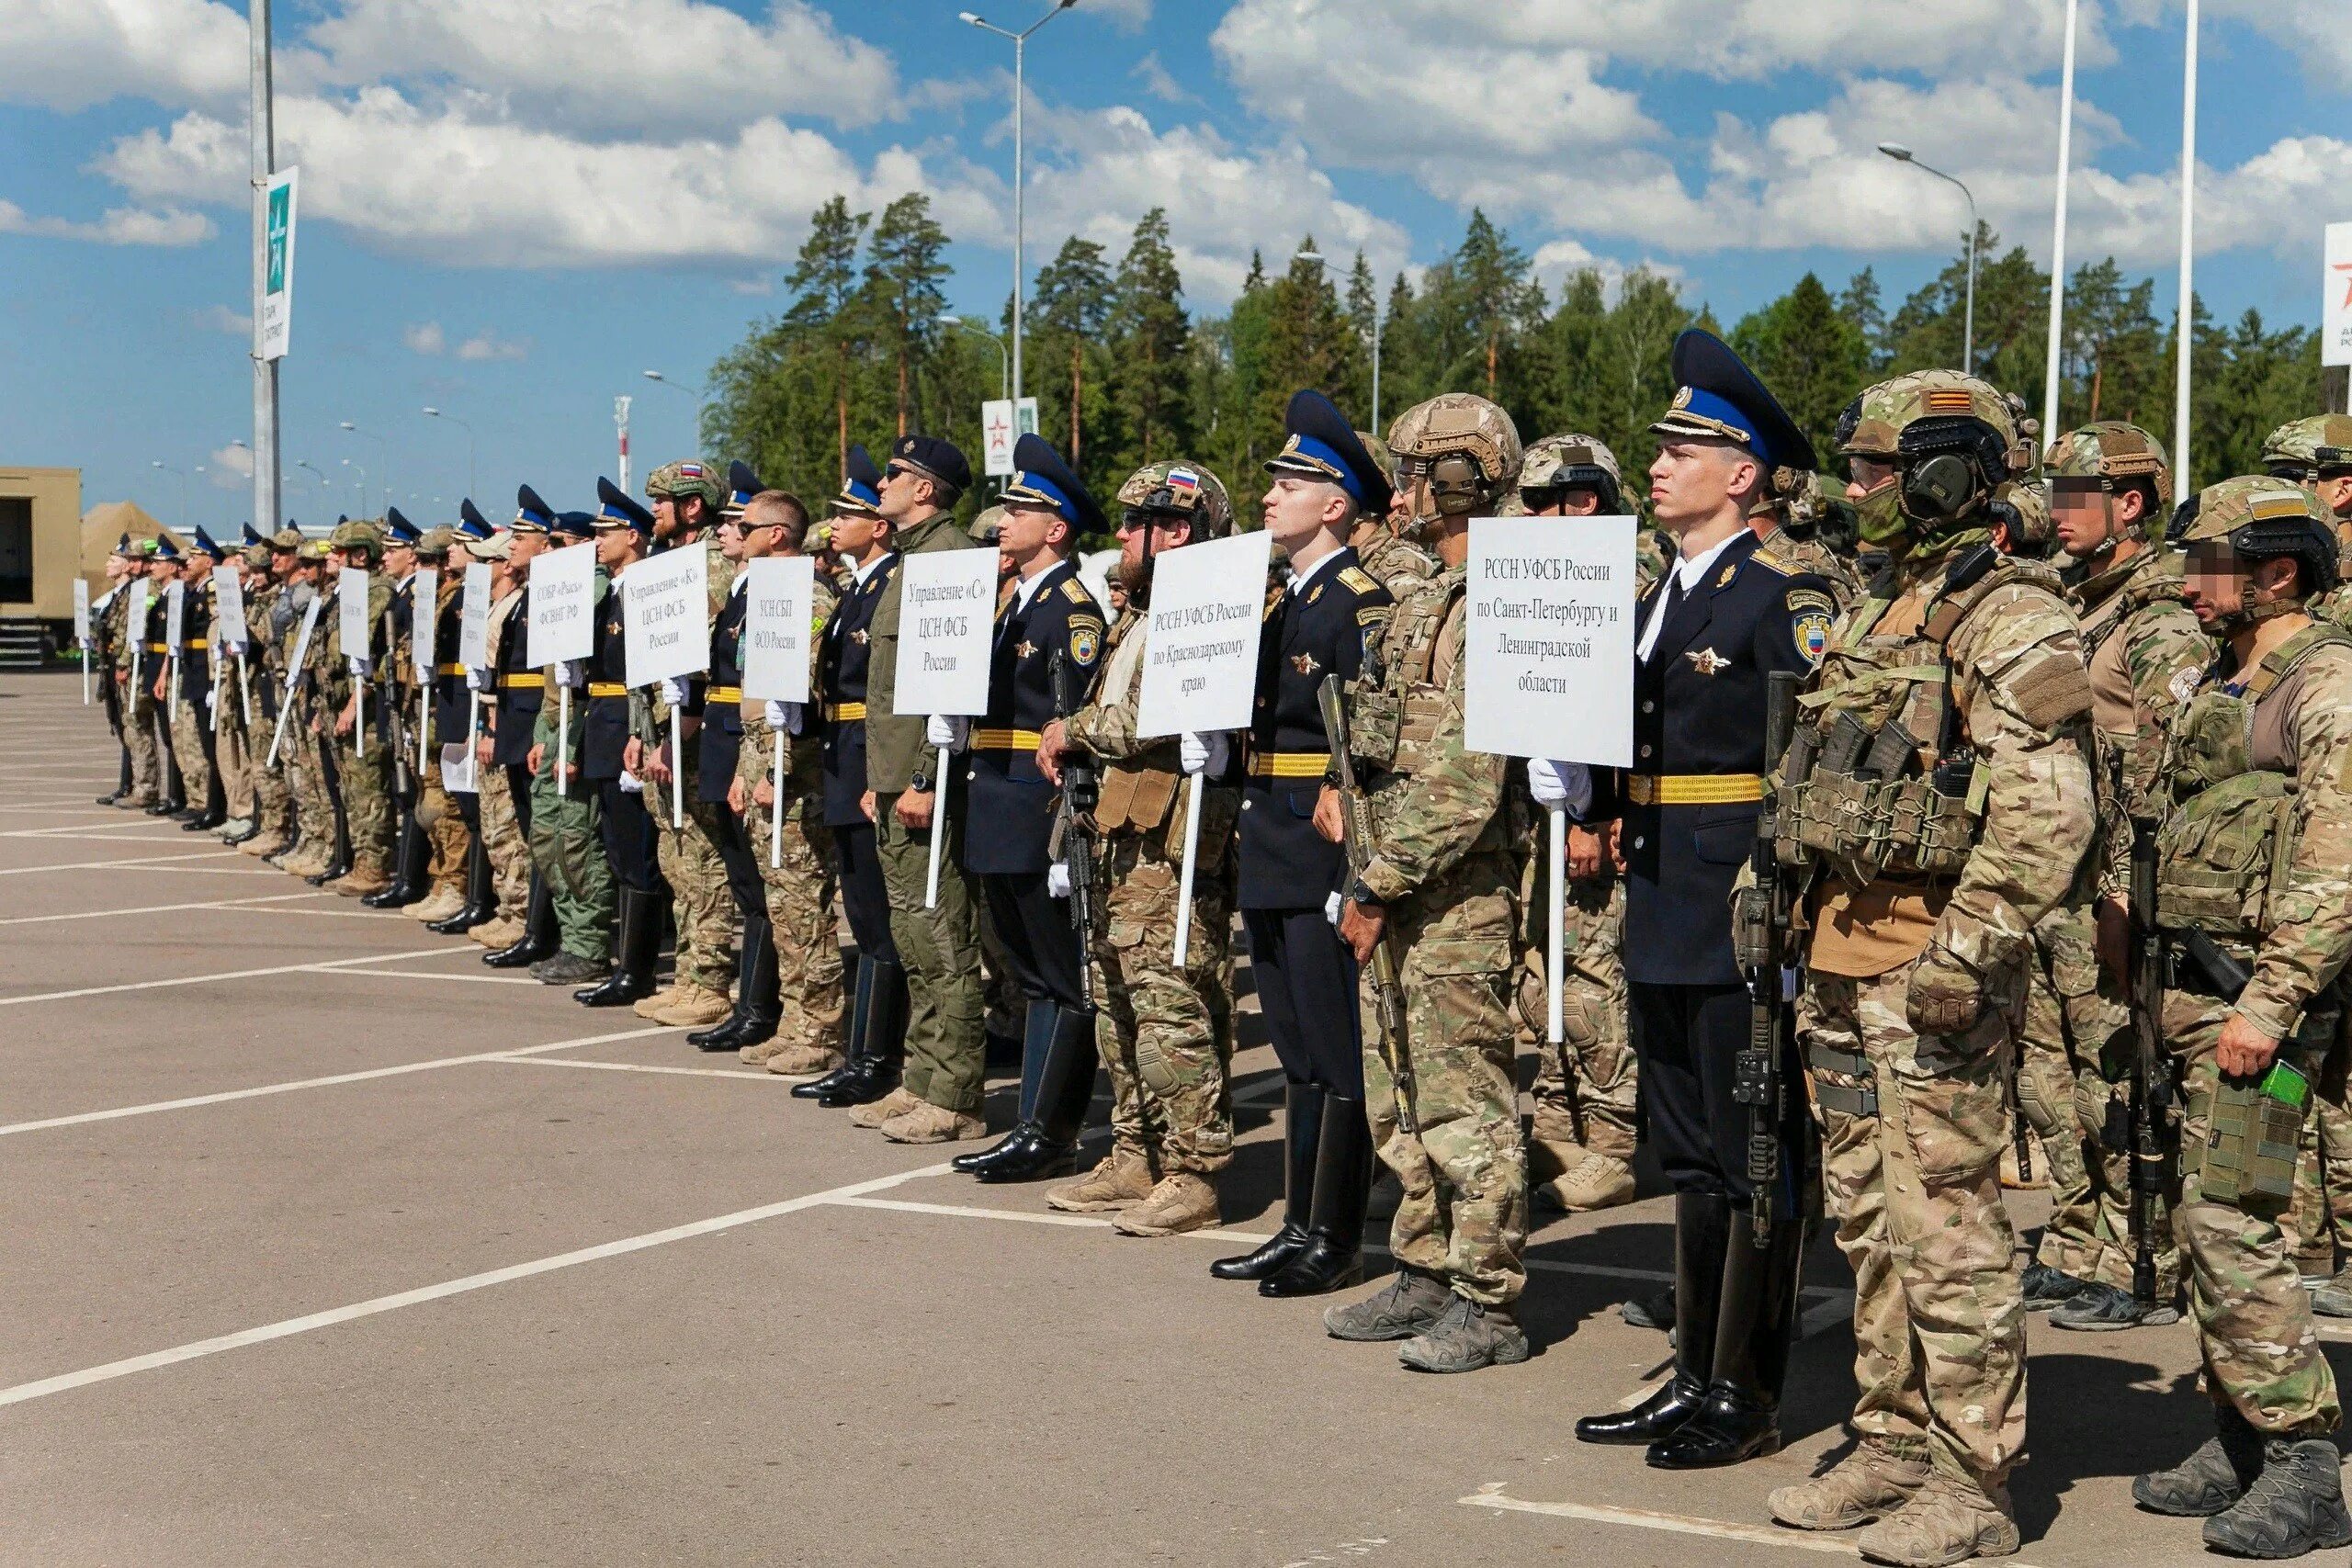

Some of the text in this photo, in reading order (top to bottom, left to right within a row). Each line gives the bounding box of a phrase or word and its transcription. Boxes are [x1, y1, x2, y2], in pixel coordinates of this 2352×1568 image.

[1485, 558, 1611, 581] РССН УФСБ России
[629, 568, 698, 603] Управление «К»
[909, 579, 987, 607] Управление «С»
[641, 599, 685, 627] ЦСН ФСБ
[1155, 602, 1252, 632] РССН УФСБ России
[1476, 597, 1618, 627] по Санкт-Петербургу и
[919, 616, 967, 638] ЦСН ФСБ
[649, 630, 679, 650] России
[771, 632, 797, 649] России
[1154, 637, 1245, 668] по Краснодарскому
[1498, 632, 1591, 661] Ленинградской
[923, 651, 956, 671] России
[1182, 675, 1205, 696] краю
[1518, 671, 1566, 694] области
